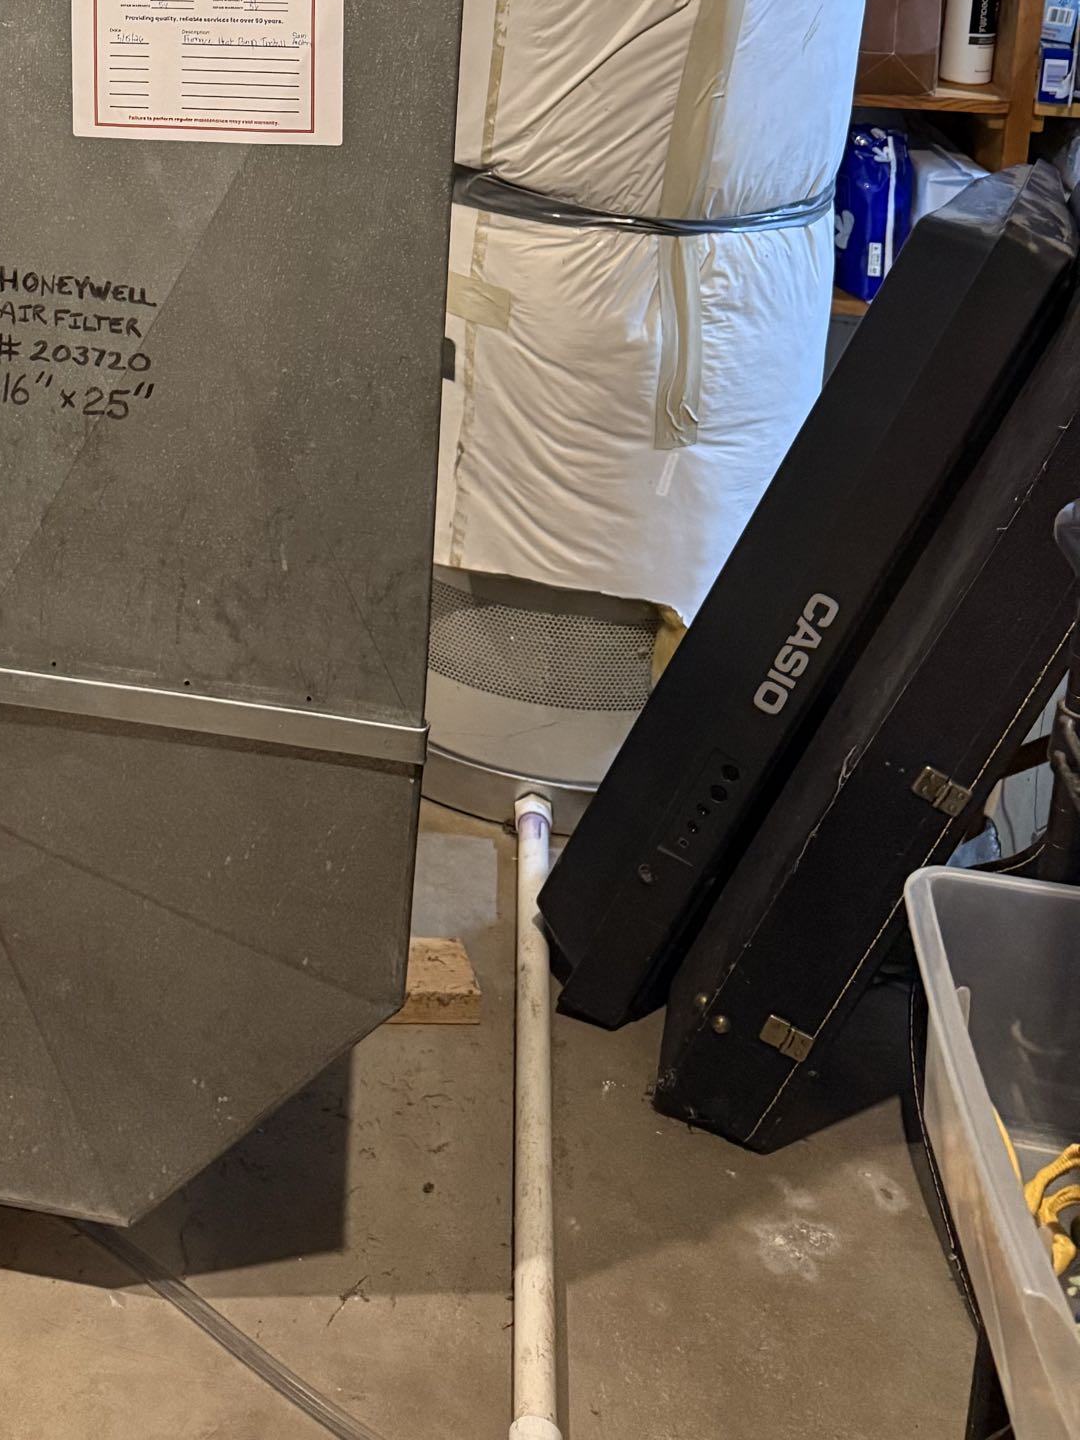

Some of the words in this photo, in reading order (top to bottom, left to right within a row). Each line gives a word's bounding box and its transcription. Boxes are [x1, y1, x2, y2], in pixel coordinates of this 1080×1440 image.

[0, 301, 47, 325] AIR
[53, 309, 142, 338] FILTER
[3, 371, 53, 405] 16"
[82, 381, 155, 420] 25"
[753, 592, 839, 715] CASIO
